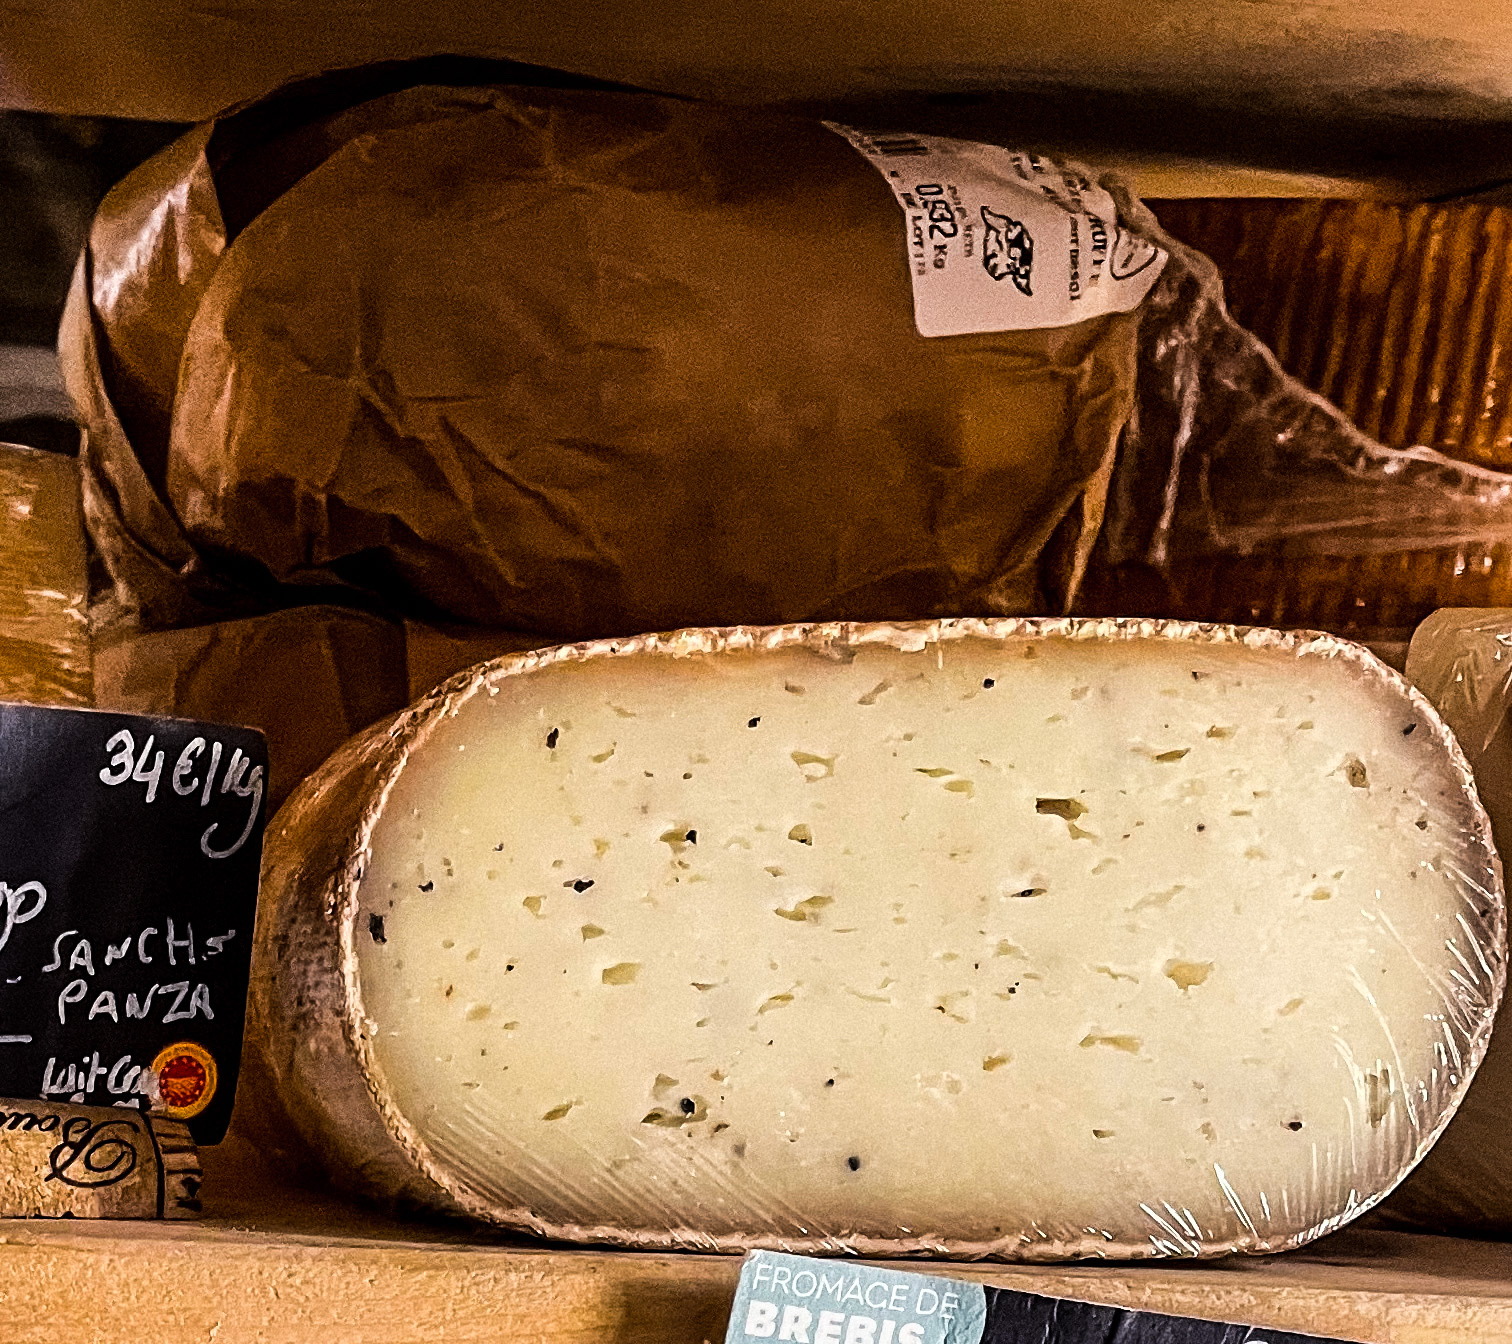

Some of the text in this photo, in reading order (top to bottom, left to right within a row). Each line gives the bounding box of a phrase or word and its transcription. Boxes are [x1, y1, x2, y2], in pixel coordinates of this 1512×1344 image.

[58, 978, 215, 1025] PANZA
[752, 1263, 960, 1318] FROMAGE DE
